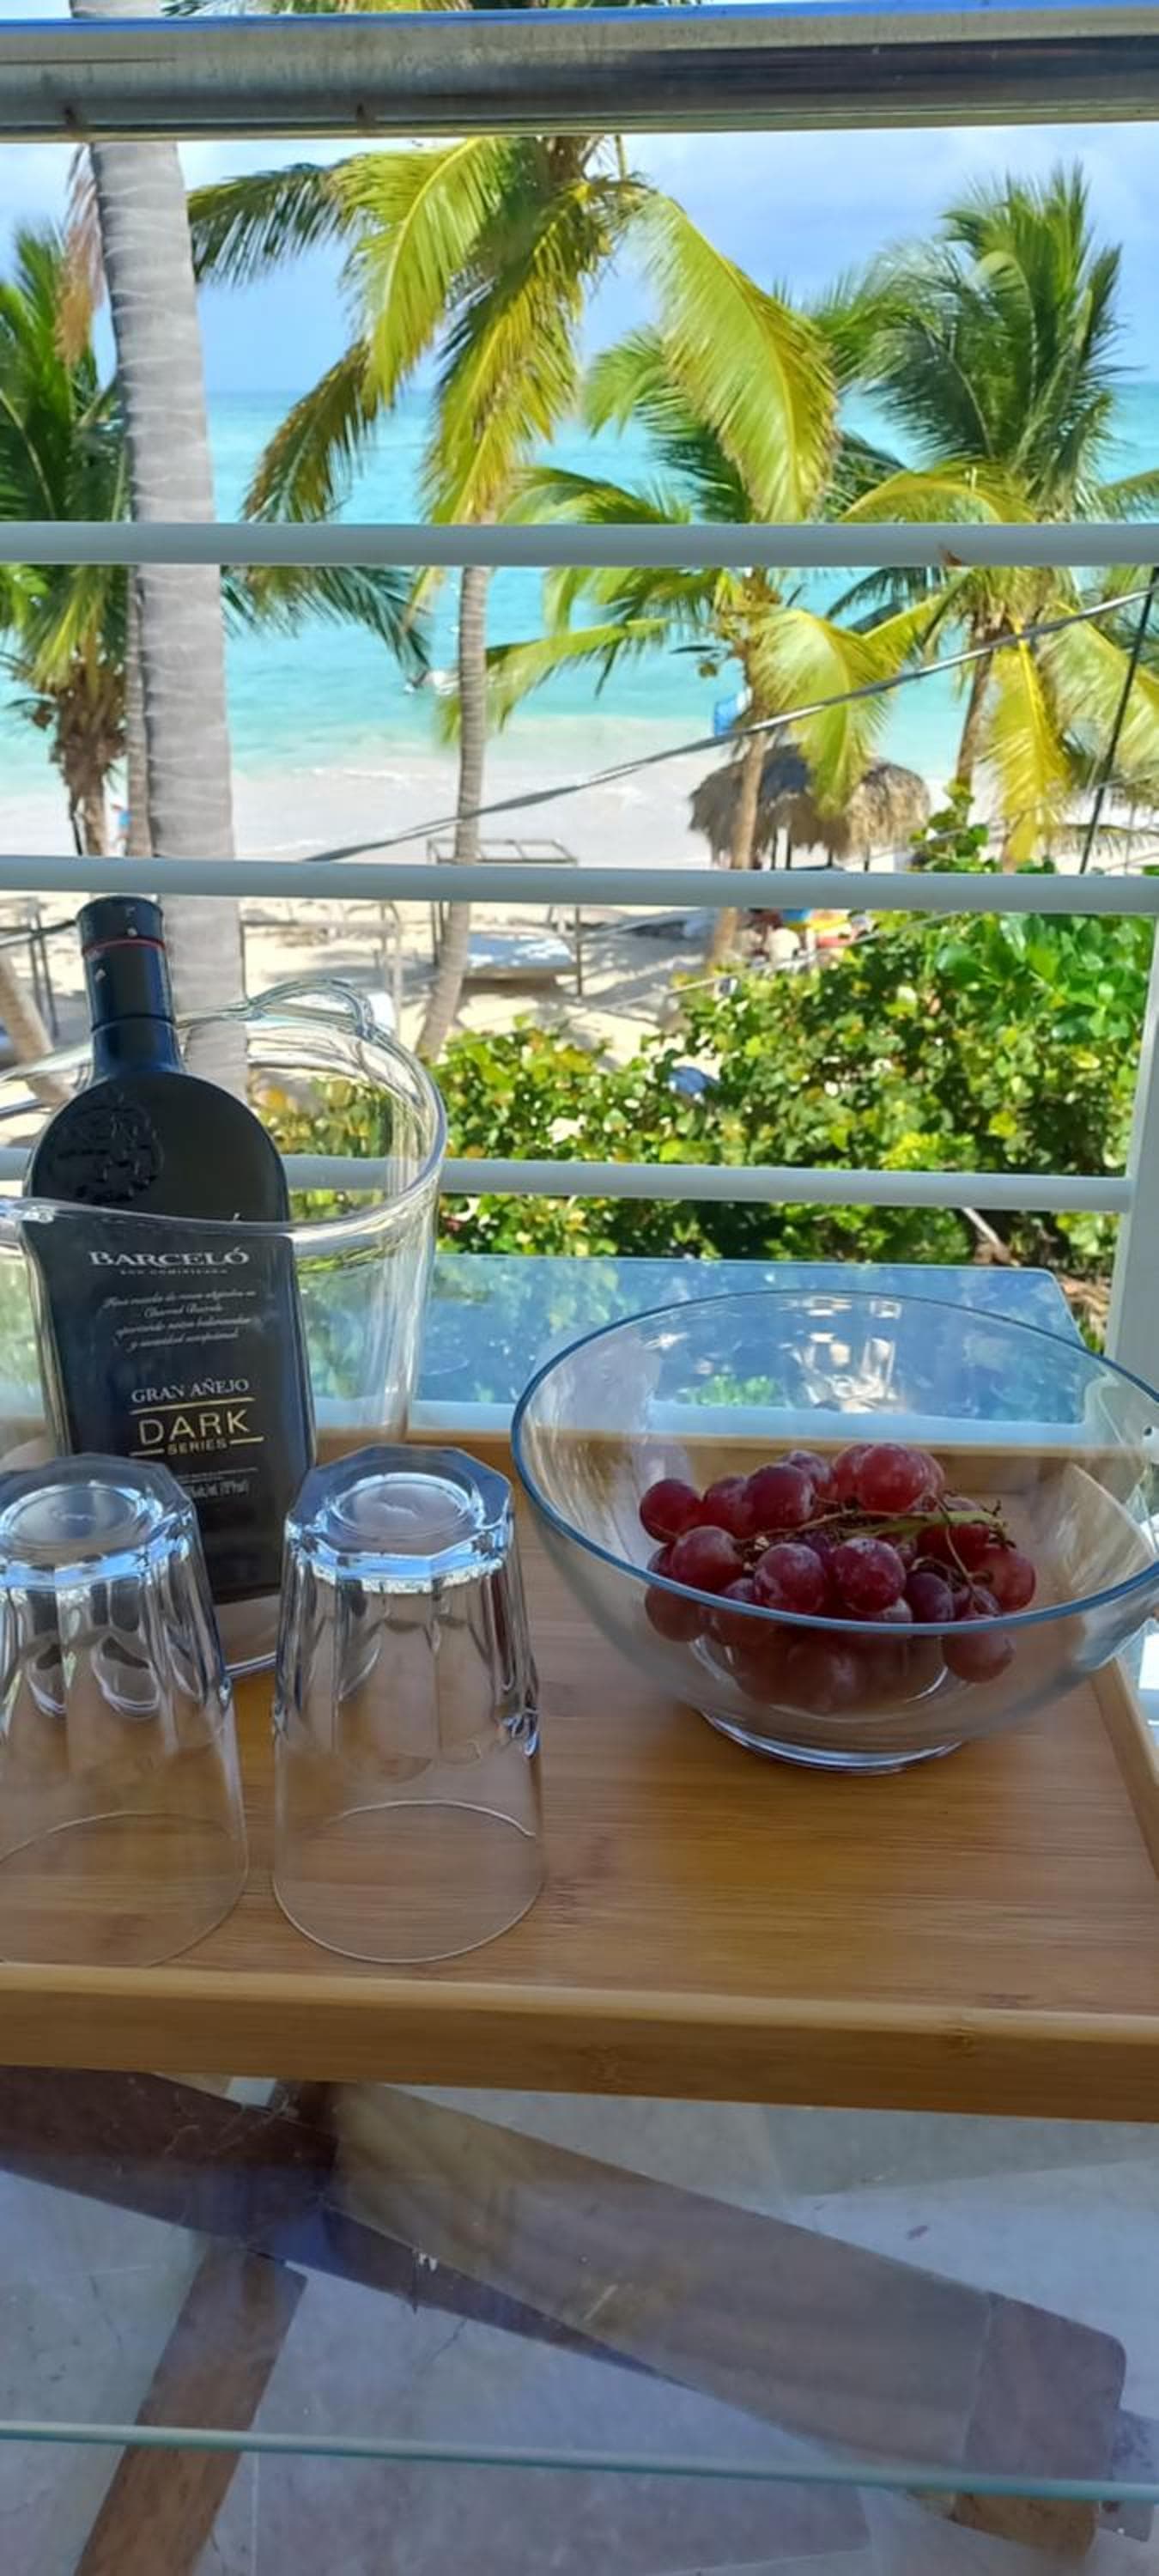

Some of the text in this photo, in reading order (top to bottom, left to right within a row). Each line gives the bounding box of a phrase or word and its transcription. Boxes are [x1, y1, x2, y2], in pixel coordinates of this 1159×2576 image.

[88, 1247, 250, 1268] BARCELÓ
[131, 1377, 250, 1403] GRAN AÑEJO
[138, 1409, 250, 1445] DARK
[167, 1437, 228, 1455] SERIES
